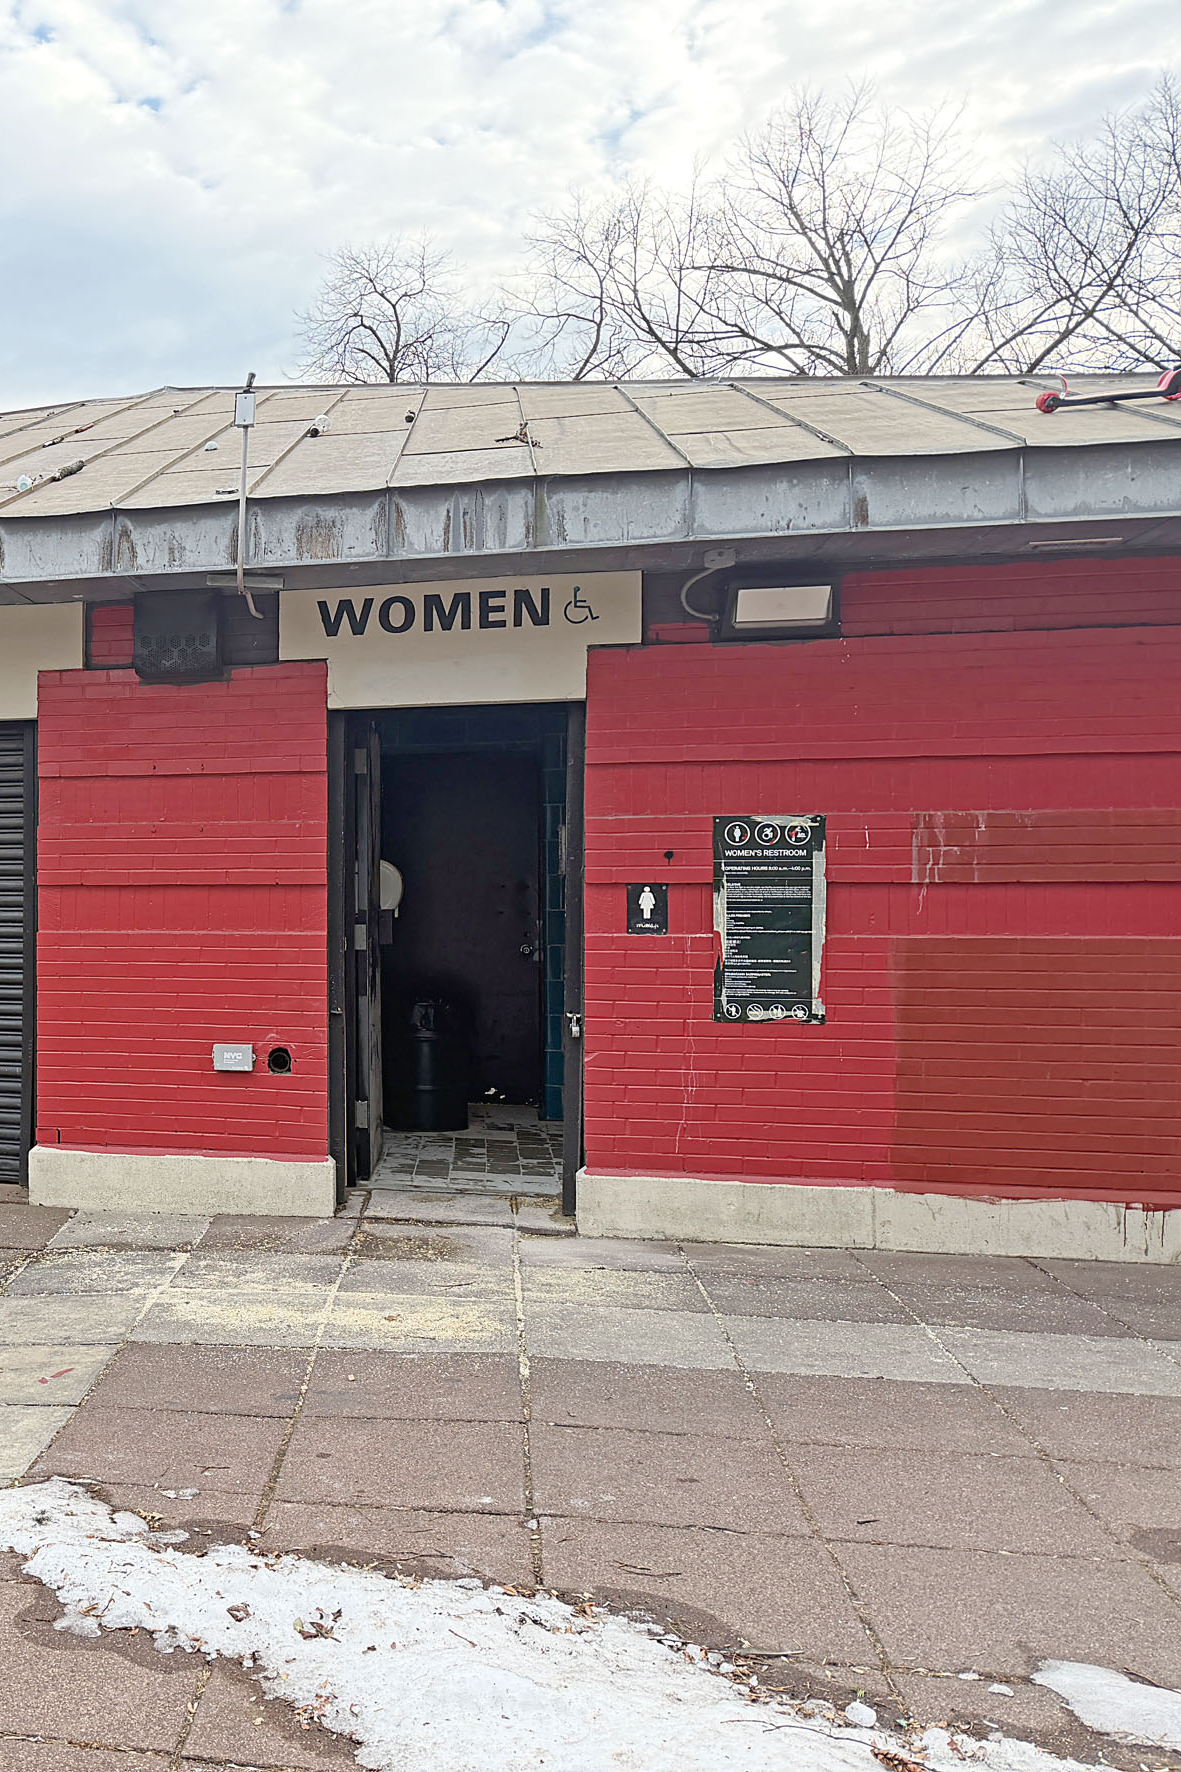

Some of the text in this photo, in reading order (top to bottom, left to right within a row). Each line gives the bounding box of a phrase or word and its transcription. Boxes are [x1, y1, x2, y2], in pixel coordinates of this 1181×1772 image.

[317, 587, 550, 637] WOMEN
[724, 849, 807, 857] WOMEN'S RESTROOM
